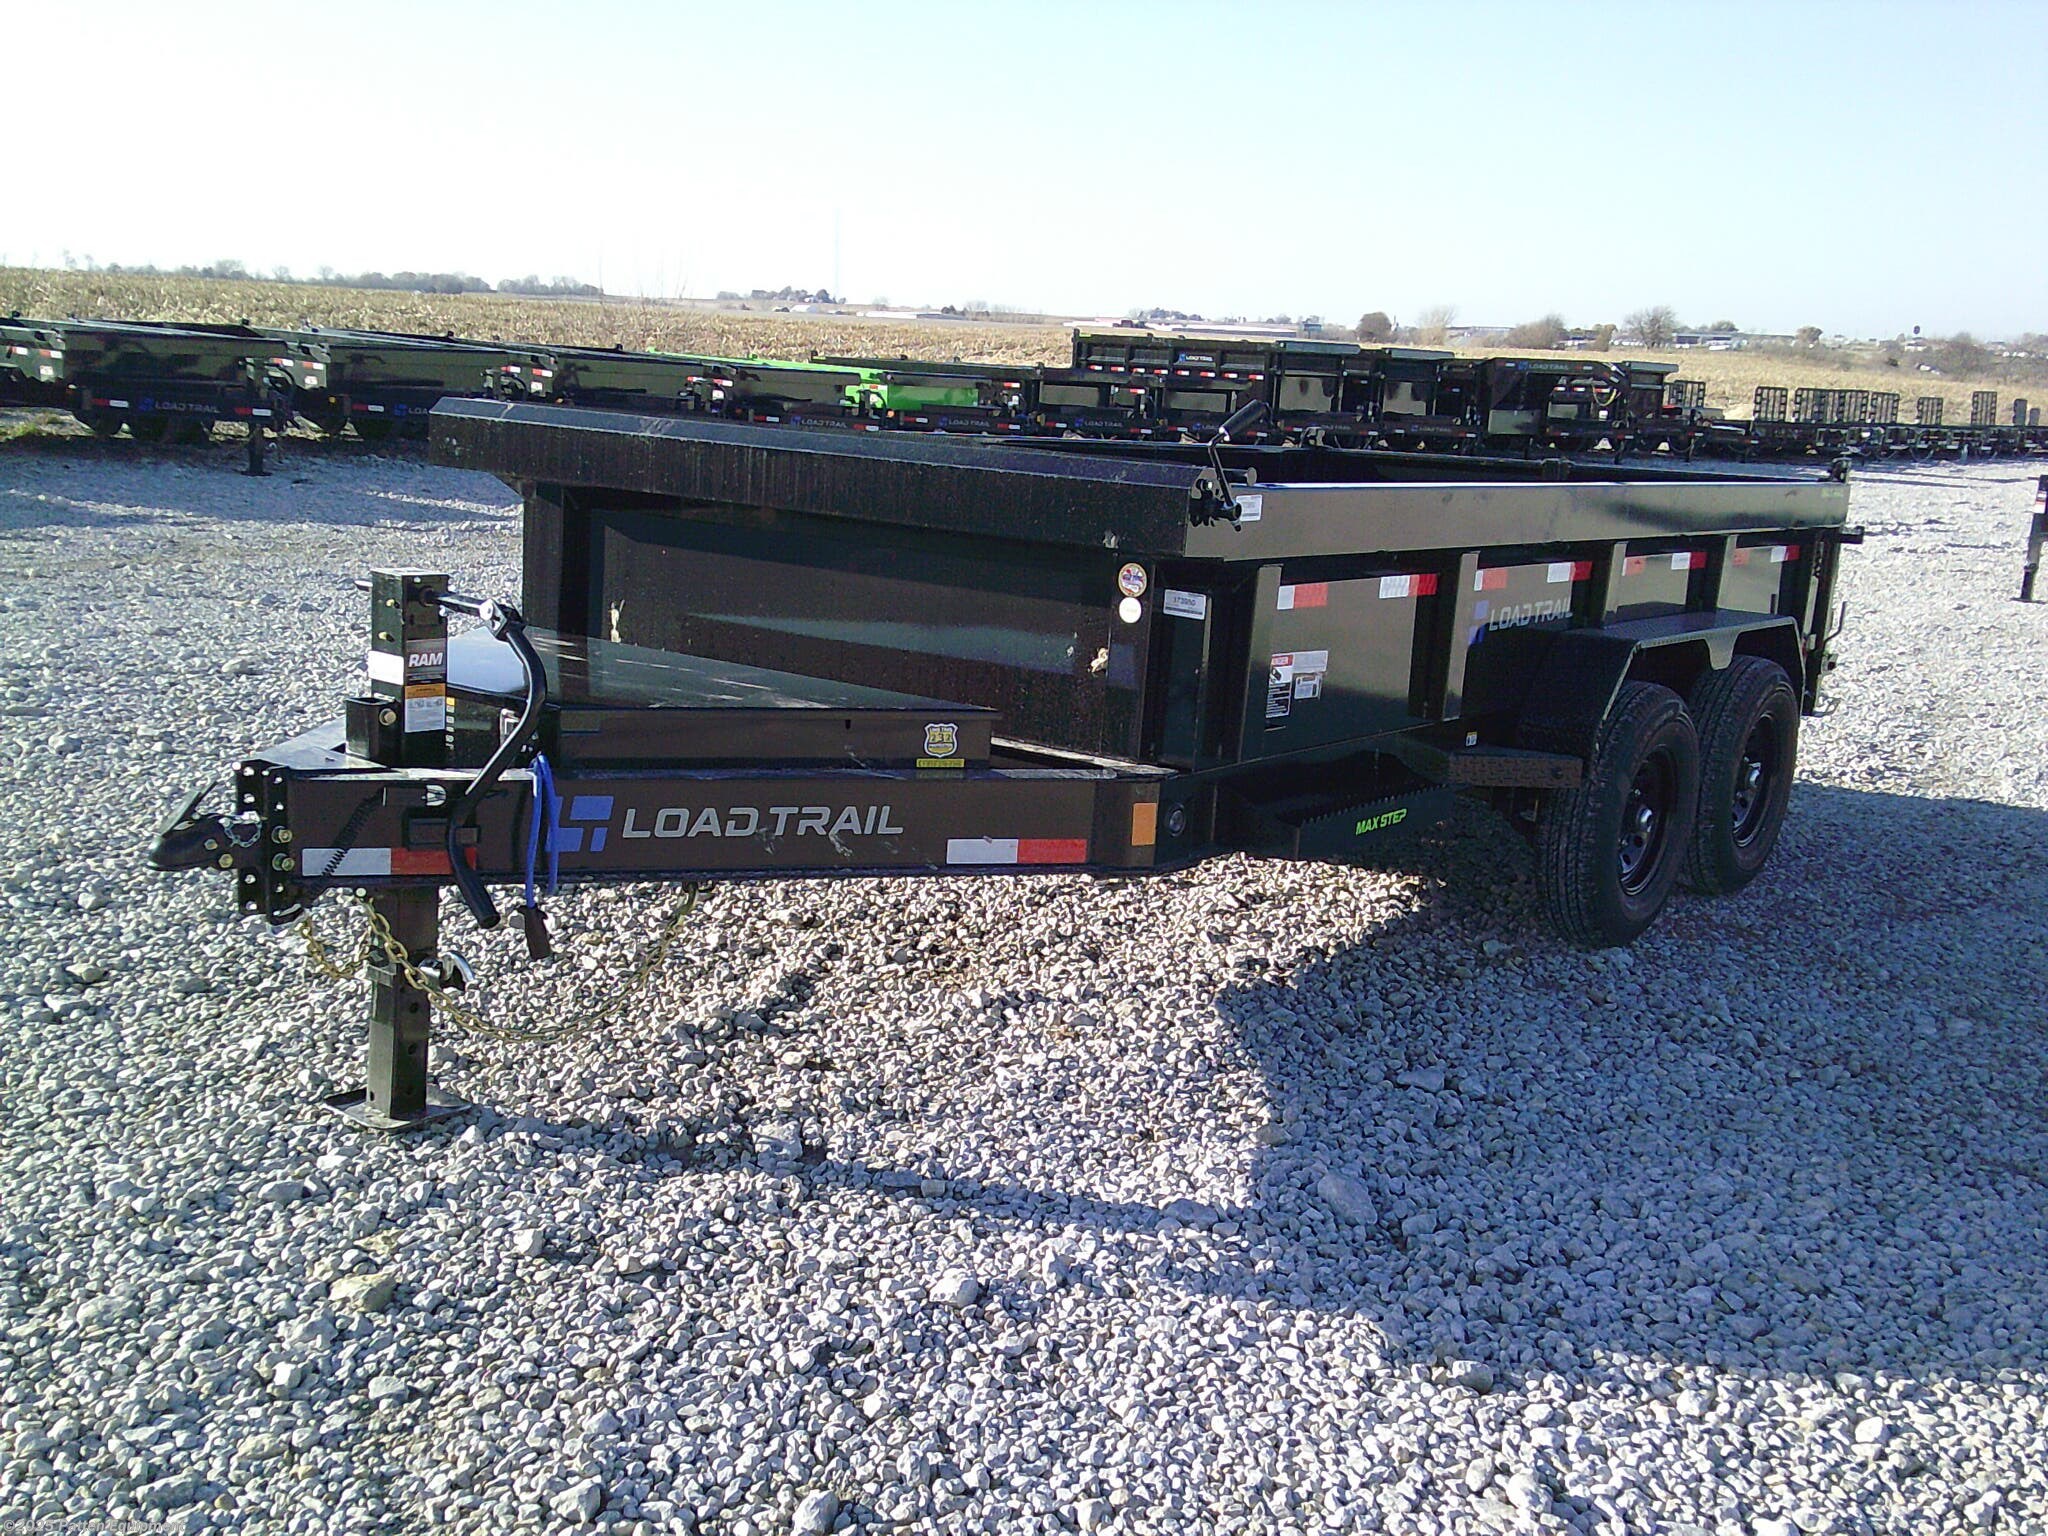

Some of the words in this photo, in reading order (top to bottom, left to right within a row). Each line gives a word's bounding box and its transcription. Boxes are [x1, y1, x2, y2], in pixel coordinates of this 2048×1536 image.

[1489, 602, 1532, 632] LOAD
[1534, 597, 1573, 624] TRAIL
[408, 651, 444, 668] RAM
[622, 806, 760, 838] LOAD
[768, 805, 904, 836] TRAIL
[1355, 815, 1380, 836] MAX
[1379, 808, 1408, 828] STEP
